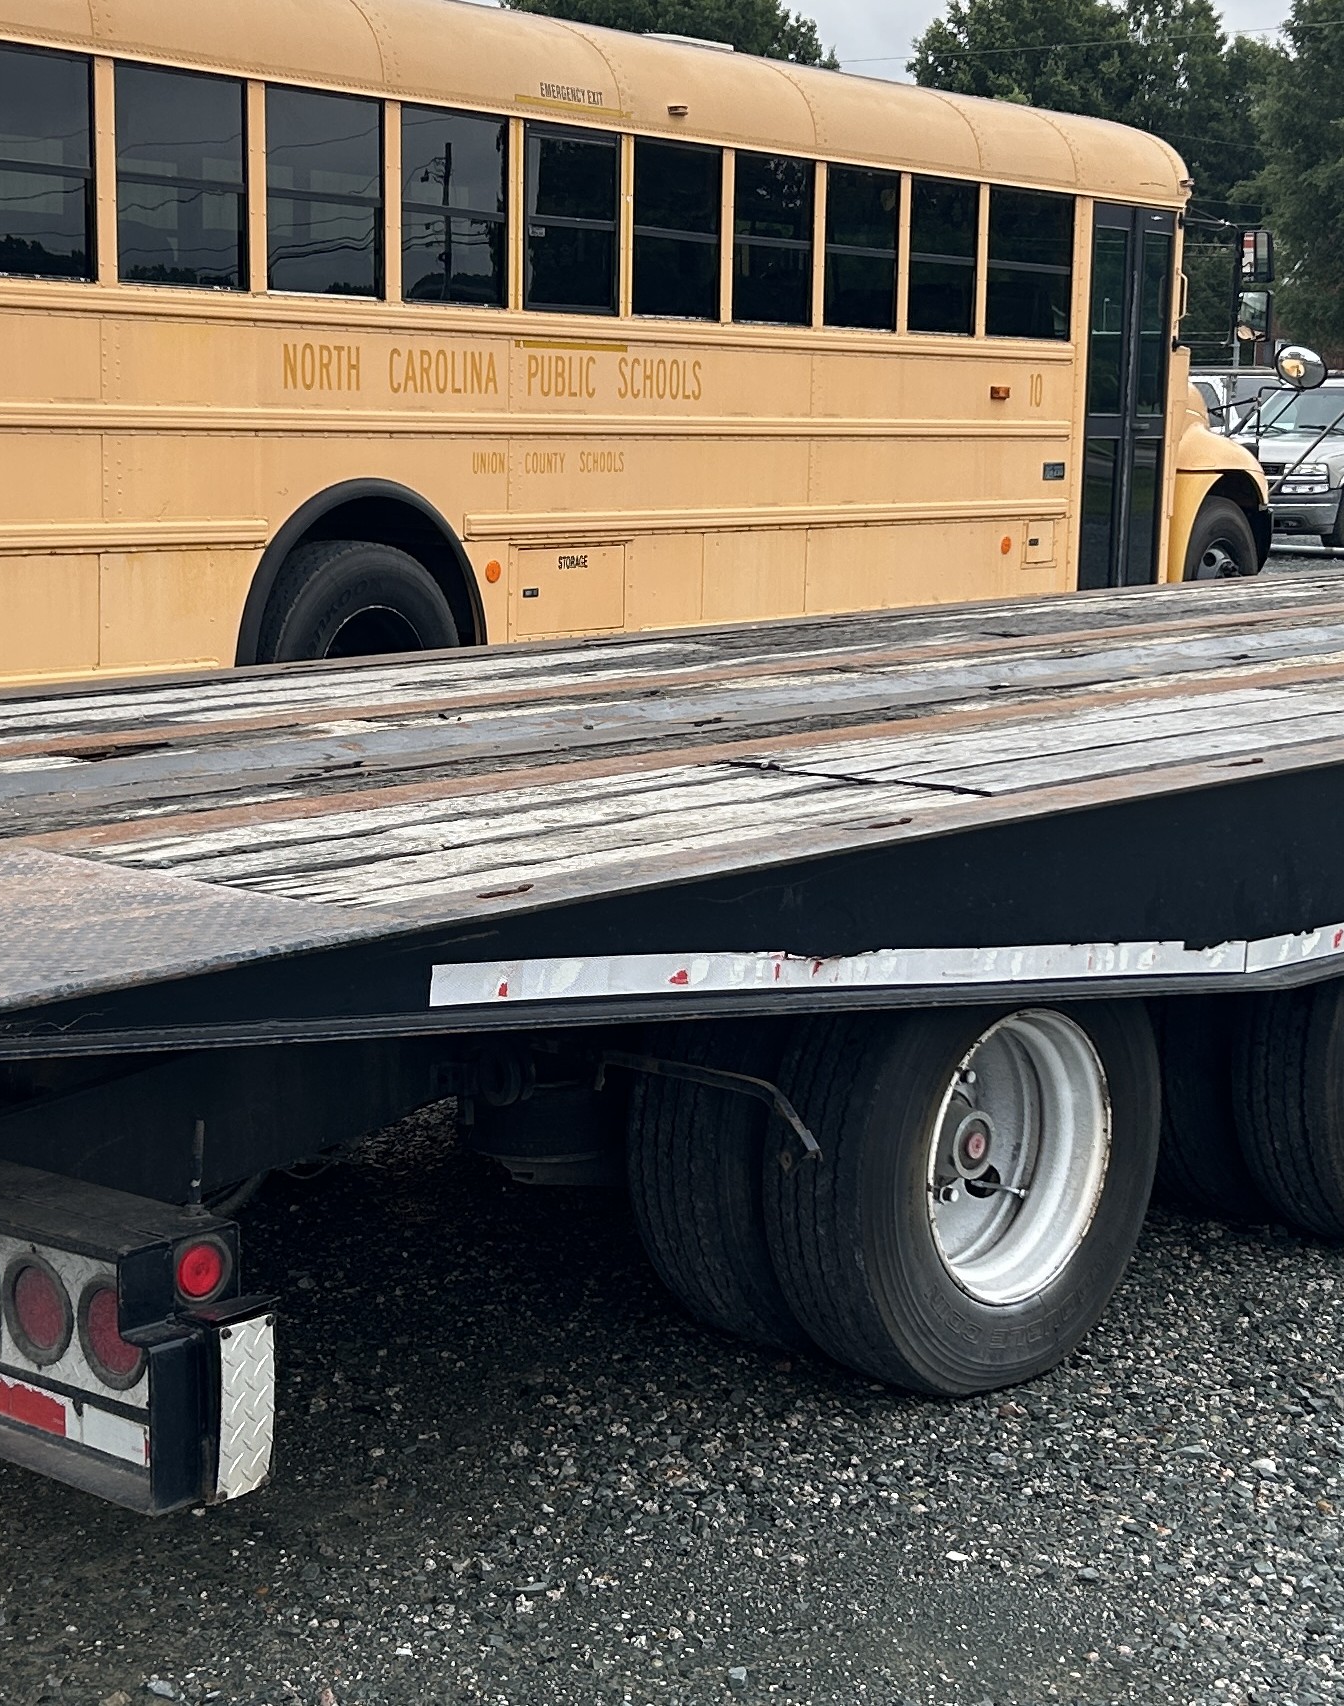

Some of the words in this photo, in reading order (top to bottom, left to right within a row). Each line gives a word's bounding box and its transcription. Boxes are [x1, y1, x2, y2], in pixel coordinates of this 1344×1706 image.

[539, 82, 586, 103] EMERGENCY
[587, 90, 603, 105] EXIT
[282, 342, 361, 392] NORTH
[388, 347, 499, 395] CAROLINA
[527, 354, 597, 399] PUBLIC
[617, 356, 703, 401] SCHOOLS
[1029, 373, 1043, 408] 10
[472, 451, 506, 475] UNION
[525, 451, 566, 475] COUNTY
[579, 451, 625, 474] SCHOOLS
[558, 554, 588, 570] STORAGE
